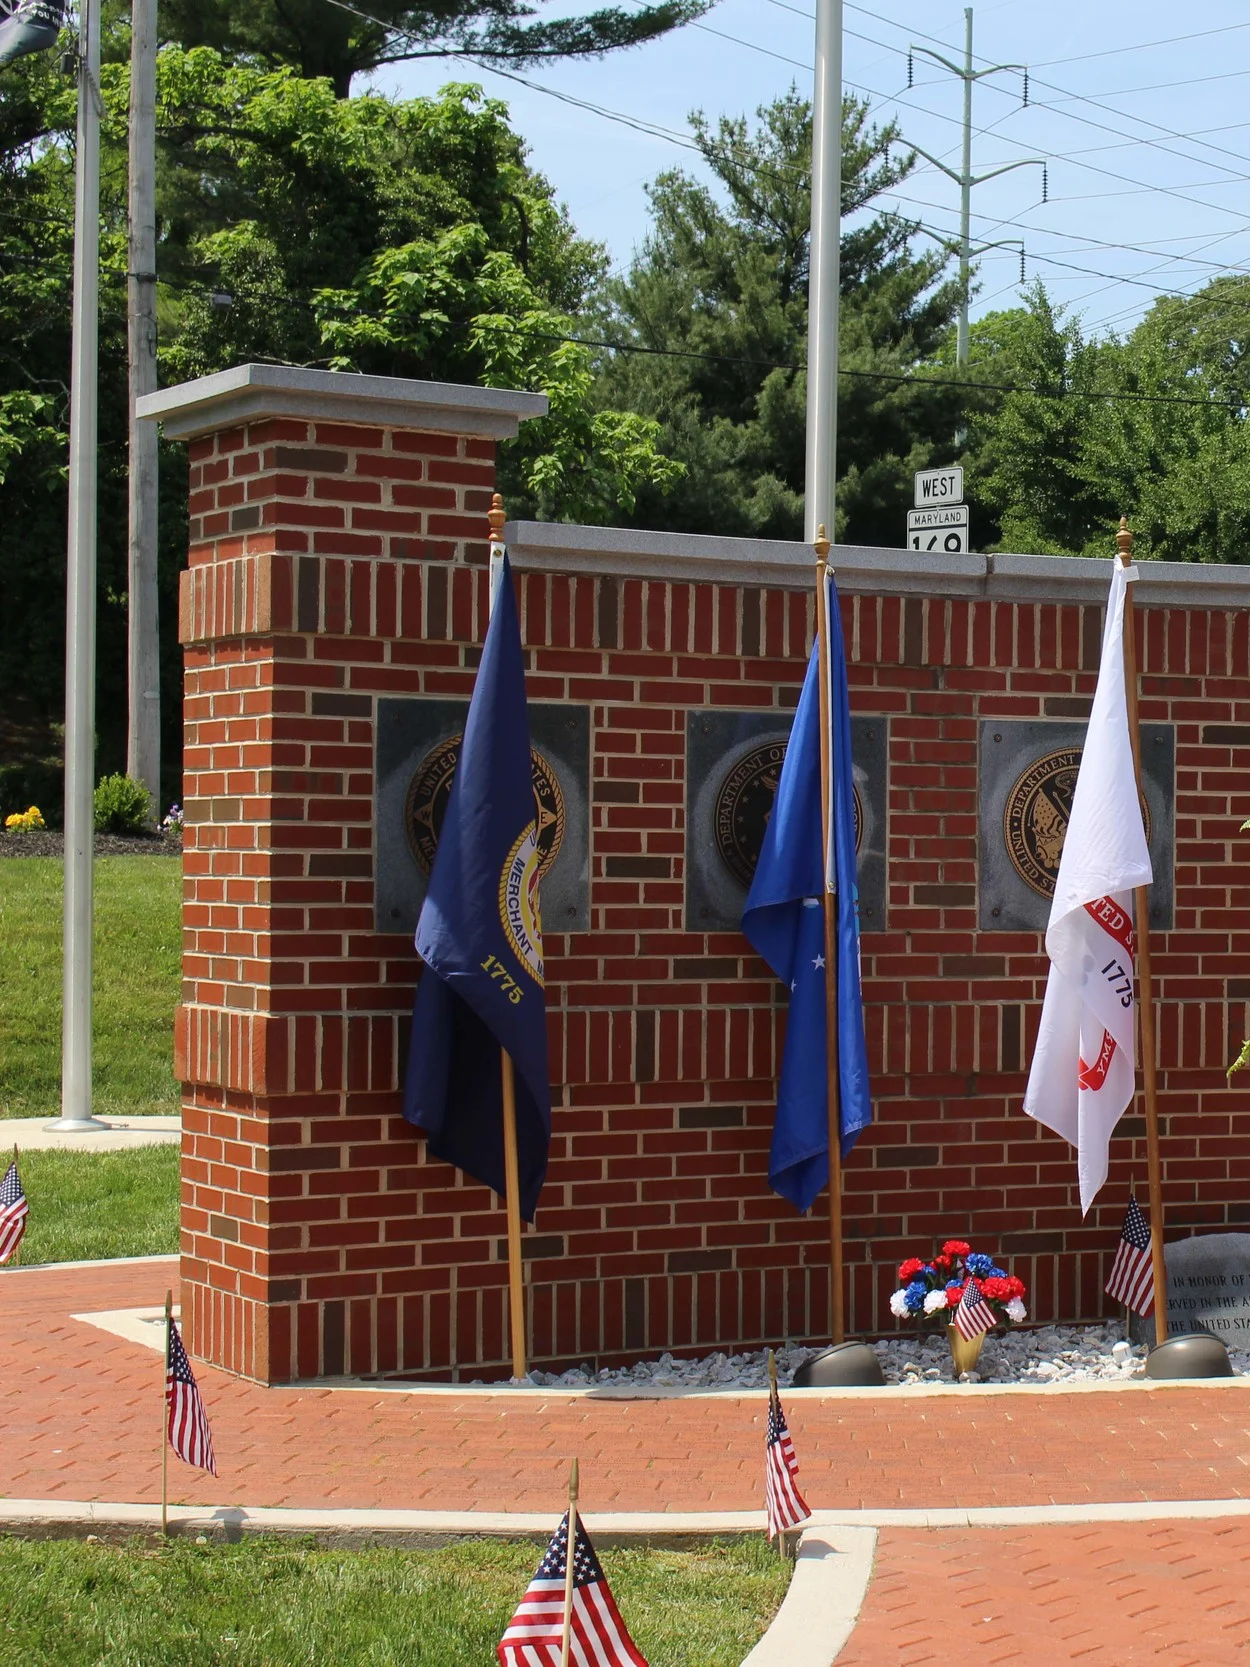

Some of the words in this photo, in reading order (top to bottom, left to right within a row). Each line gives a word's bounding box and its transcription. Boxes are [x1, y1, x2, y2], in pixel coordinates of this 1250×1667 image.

[922, 476, 956, 498] WEST
[914, 511, 962, 526] MARYLAND
[419, 752, 457, 796] UNITED
[531, 764, 551, 797] TES
[1011, 753, 1077, 819] DEPARTMENT
[719, 753, 764, 846] DEPARTMENT
[1011, 830, 1040, 880] UNITED
[507, 856, 534, 956] MERCHANT
[1090, 896, 1125, 931] TED
[480, 953, 525, 1005] 1775
[1101, 958, 1134, 1009] 1775
[1173, 1276, 1185, 1288] IN
[1188, 1275, 1227, 1287] HONOR
[1231, 1274, 1245, 1286] OF
[1200, 1297, 1212, 1308] IN
[1217, 1296, 1238, 1308] THE
[1190, 1318, 1231, 1332] UNITED
